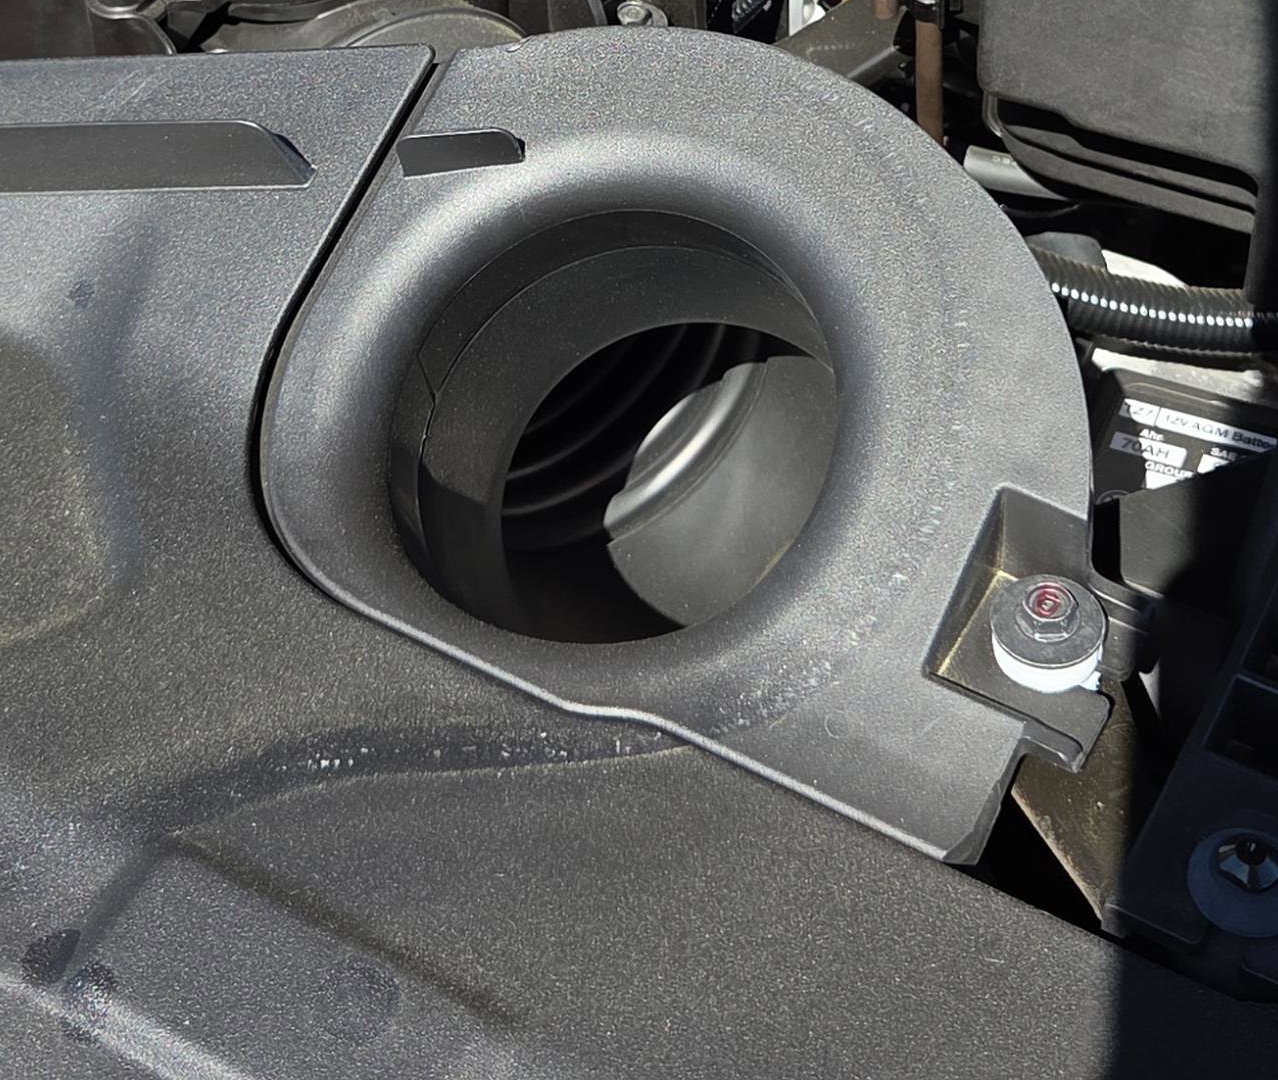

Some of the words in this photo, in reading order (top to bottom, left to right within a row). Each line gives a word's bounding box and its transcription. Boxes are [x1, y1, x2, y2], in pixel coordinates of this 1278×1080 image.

[1121, 437, 1169, 459] 70AH
[1192, 423, 1228, 438] AGM
[1232, 430, 1276, 449] Batte
